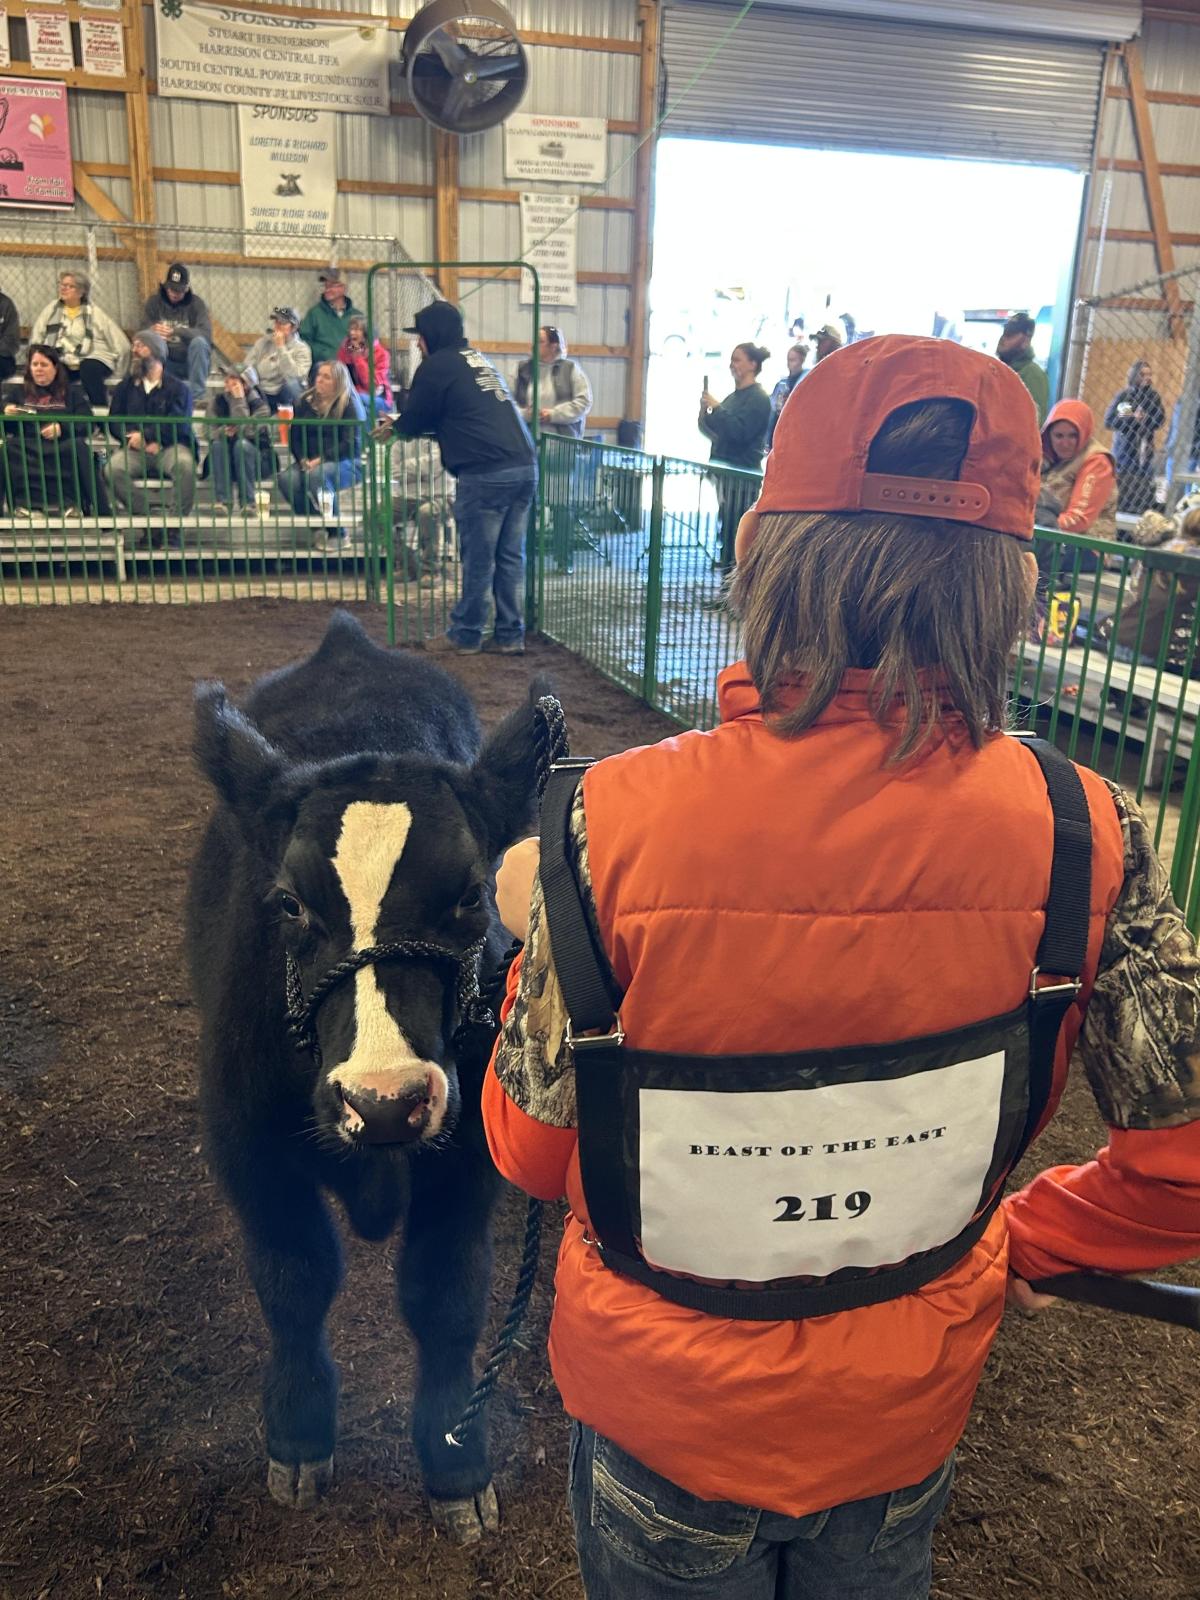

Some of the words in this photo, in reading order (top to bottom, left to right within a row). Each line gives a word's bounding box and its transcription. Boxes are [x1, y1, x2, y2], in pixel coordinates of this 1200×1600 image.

[219, 9, 317, 29] SPONSORS
[38, 29, 60, 38] Owen
[207, 26, 253, 42] STUART
[256, 33, 330, 49] HENDERSON
[198, 42, 260, 58] HARRISON
[263, 48, 317, 65] CENTRAL
[318, 54, 339, 67] FFA
[160, 57, 201, 73] SOUTH
[203, 62, 258, 79] CENTRAL
[260, 68, 301, 83] POWER
[303, 72, 379, 88] FOUNDATION
[160, 76, 223, 93] HARRISON
[224, 83, 272, 98] COUNTY
[290, 88, 353, 105] LIVESTOCK
[354, 94, 384, 107] SALE
[252, 104, 319, 123] SPONSORS
[249, 135, 283, 148] LORETTA
[293, 139, 329, 151] RICHARD
[689, 1144, 771, 1157] BEAST
[781, 1144, 814, 1157] OF
[823, 1138, 877, 1154] THE
[885, 1126, 947, 1148] EAST
[772, 1190, 872, 1222] 219
